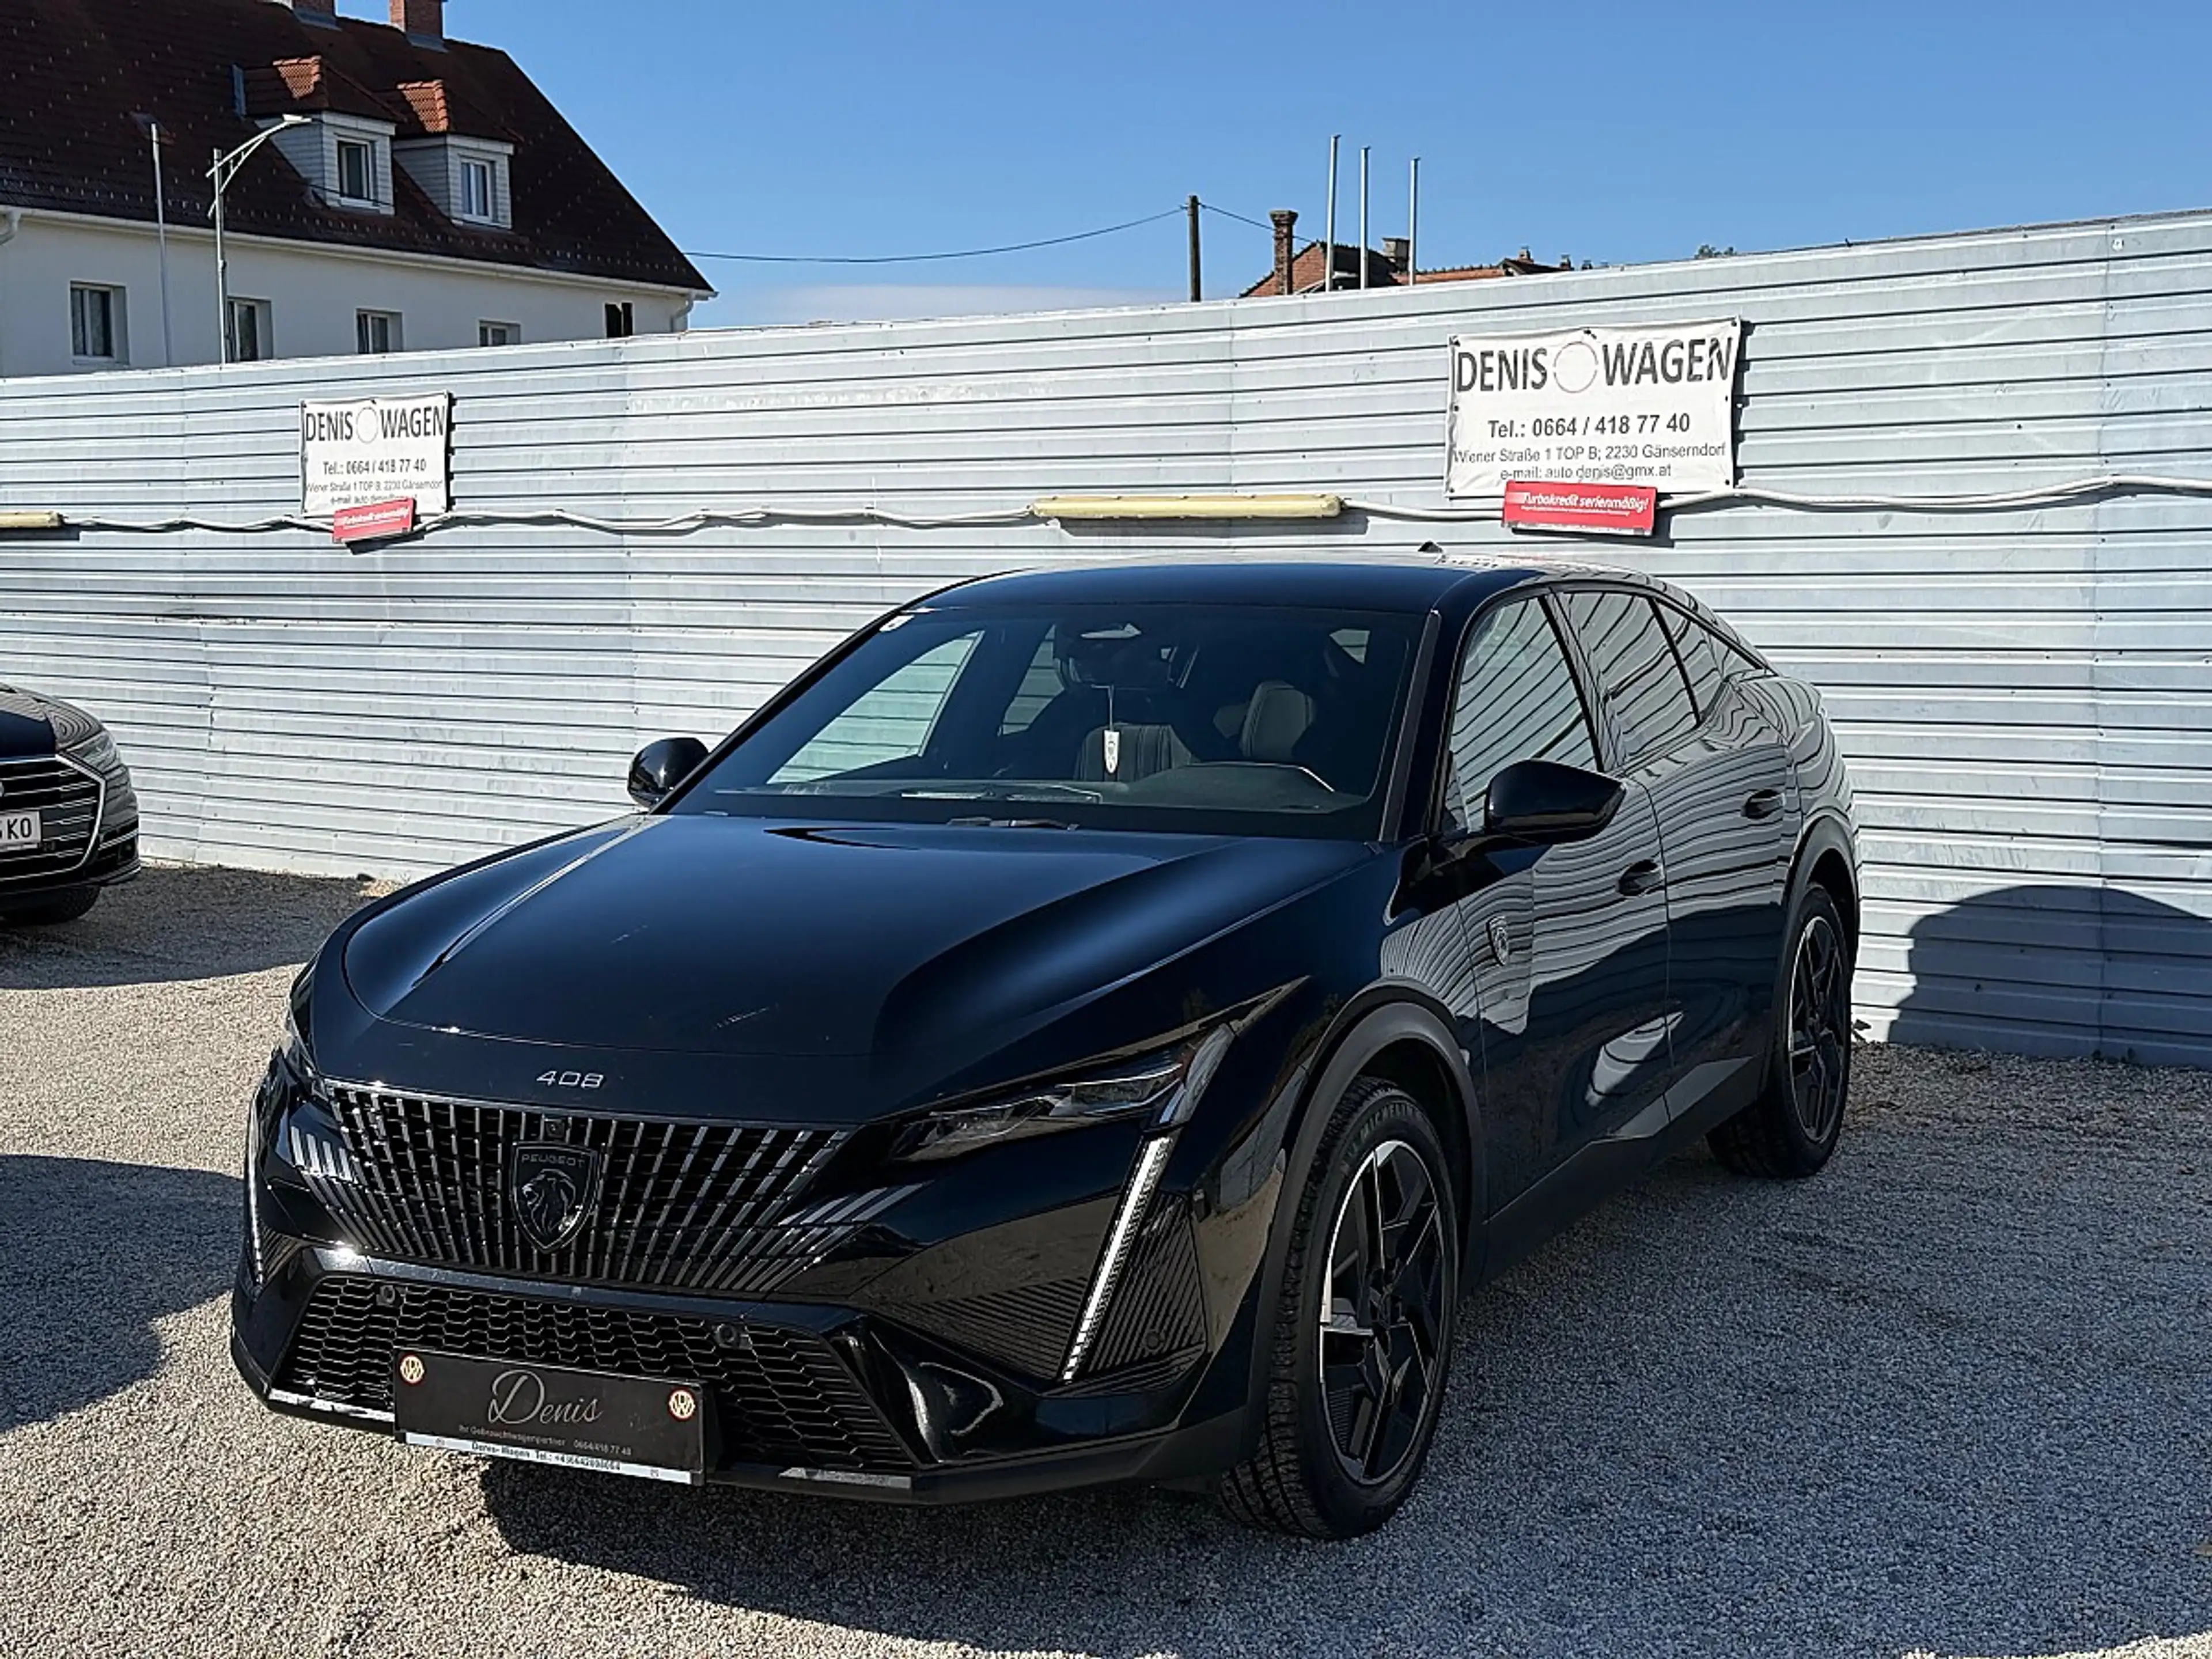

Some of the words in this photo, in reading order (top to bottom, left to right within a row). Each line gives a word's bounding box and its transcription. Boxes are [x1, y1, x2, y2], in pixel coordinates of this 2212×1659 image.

[1456, 348, 1548, 392] DENIS
[1603, 337, 1733, 386] WAGEN
[306, 411, 353, 441] DENIS
[380, 406, 445, 438] WAGEN
[1488, 420, 1525, 438] Tel.:
[1532, 416, 1577, 437] 0664
[1583, 416, 1590, 435] /
[1594, 415, 1630, 434] 418
[1637, 415, 1660, 434] 77
[1666, 413, 1690, 432] 40
[1453, 448, 1496, 463] Wiener
[1499, 448, 1540, 461] Straße
[1545, 447, 1551, 460] 1
[1556, 446, 1584, 460] TOP
[1605, 444, 1638, 460] 2230
[1642, 442, 1726, 458] Gänserndorf
[346, 460, 369, 474] 0664
[378, 459, 396, 472] 418
[399, 459, 411, 472] 77
[413, 459, 427, 471] 40
[536, 1070, 604, 1089] 408
[521, 1153, 586, 1169] PEUGEOT
[487, 1369, 604, 1425] Denis
